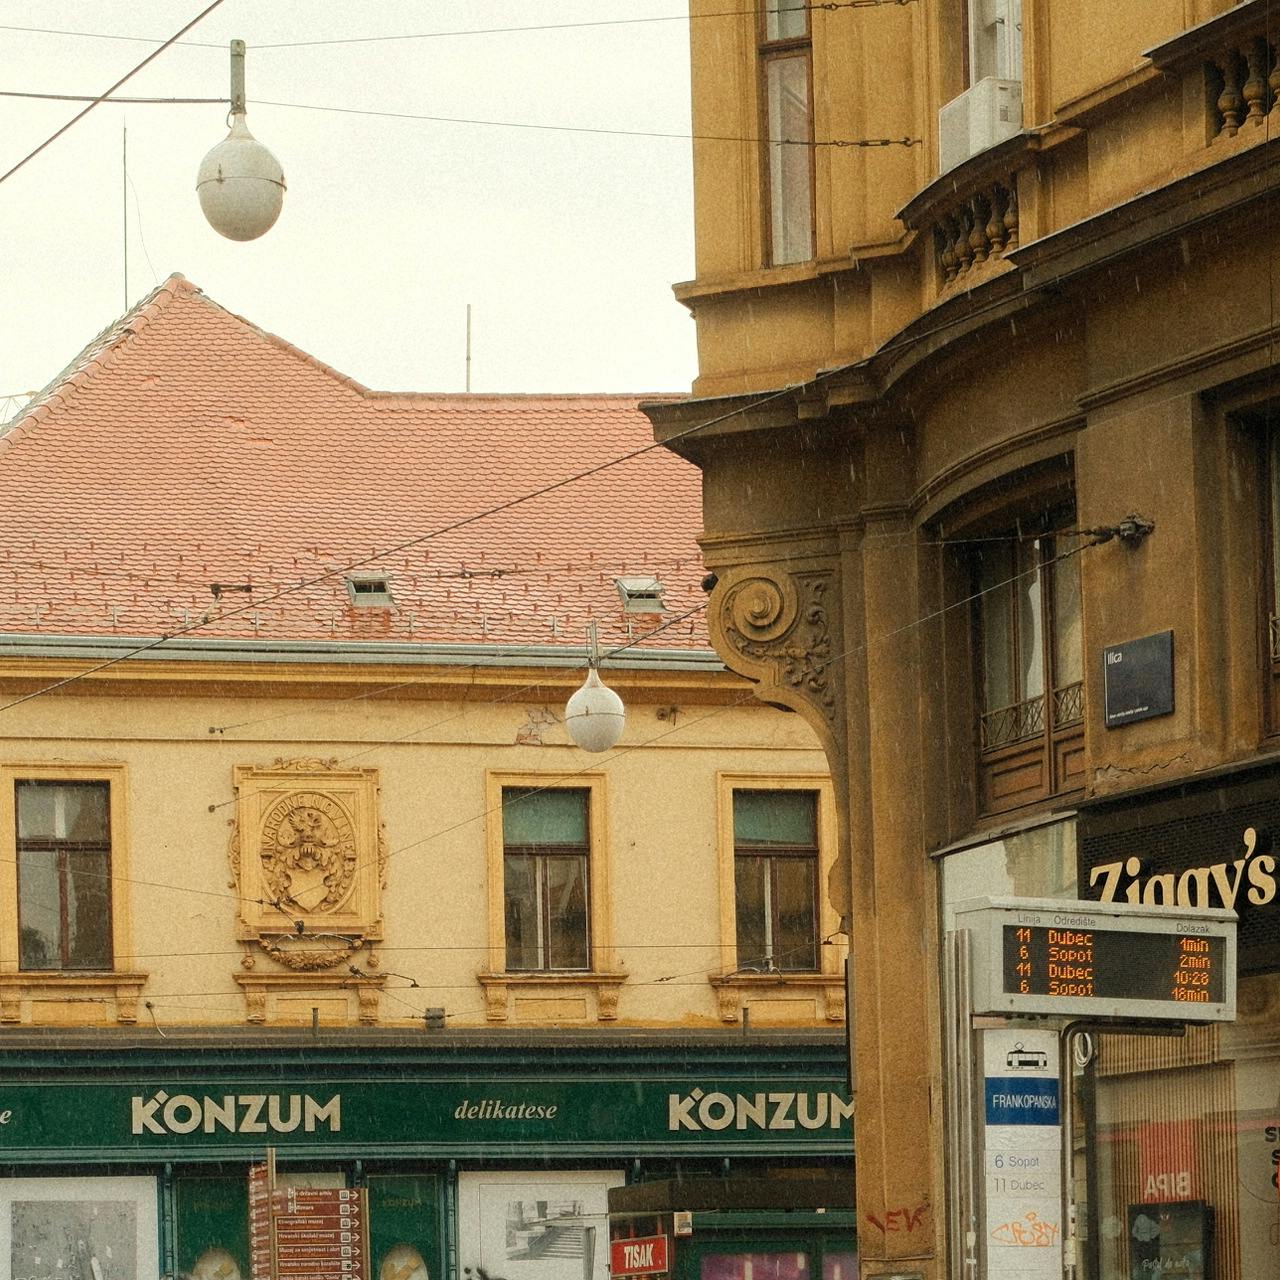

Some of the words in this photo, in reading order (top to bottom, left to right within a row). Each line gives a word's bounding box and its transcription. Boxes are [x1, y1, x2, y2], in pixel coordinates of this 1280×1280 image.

[1107, 652, 1122, 665] Ilica
[1018, 915, 1041, 924] Linija
[1054, 915, 1096, 927] Odredište
[1176, 923, 1210, 934] Dolazak
[1016, 928, 1031, 943] 11
[1048, 930, 1093, 946] Dubec
[1179, 938, 1209, 952] 1min
[1019, 946, 1029, 960] 6
[1048, 948, 1093, 963] Sopot
[1179, 956, 1211, 969] 2min
[1016, 963, 1031, 977] 11
[1048, 964, 1093, 980] Dubec
[1019, 980, 1029, 994] 6
[1048, 982, 1093, 997] Sopot
[454, 1100, 558, 1122] delikatese
[668, 1087, 855, 1131] KONZUM
[992, 1094, 1057, 1109] FRANKOPANSKA
[131, 1089, 341, 1135] KONZUM
[995, 1154, 1004, 1169] 6
[1008, 1155, 1039, 1169] Sopot
[994, 1178, 1006, 1192] 11
[1010, 1178, 1045, 1191] Dubec
[623, 1243, 654, 1269] TISAK
